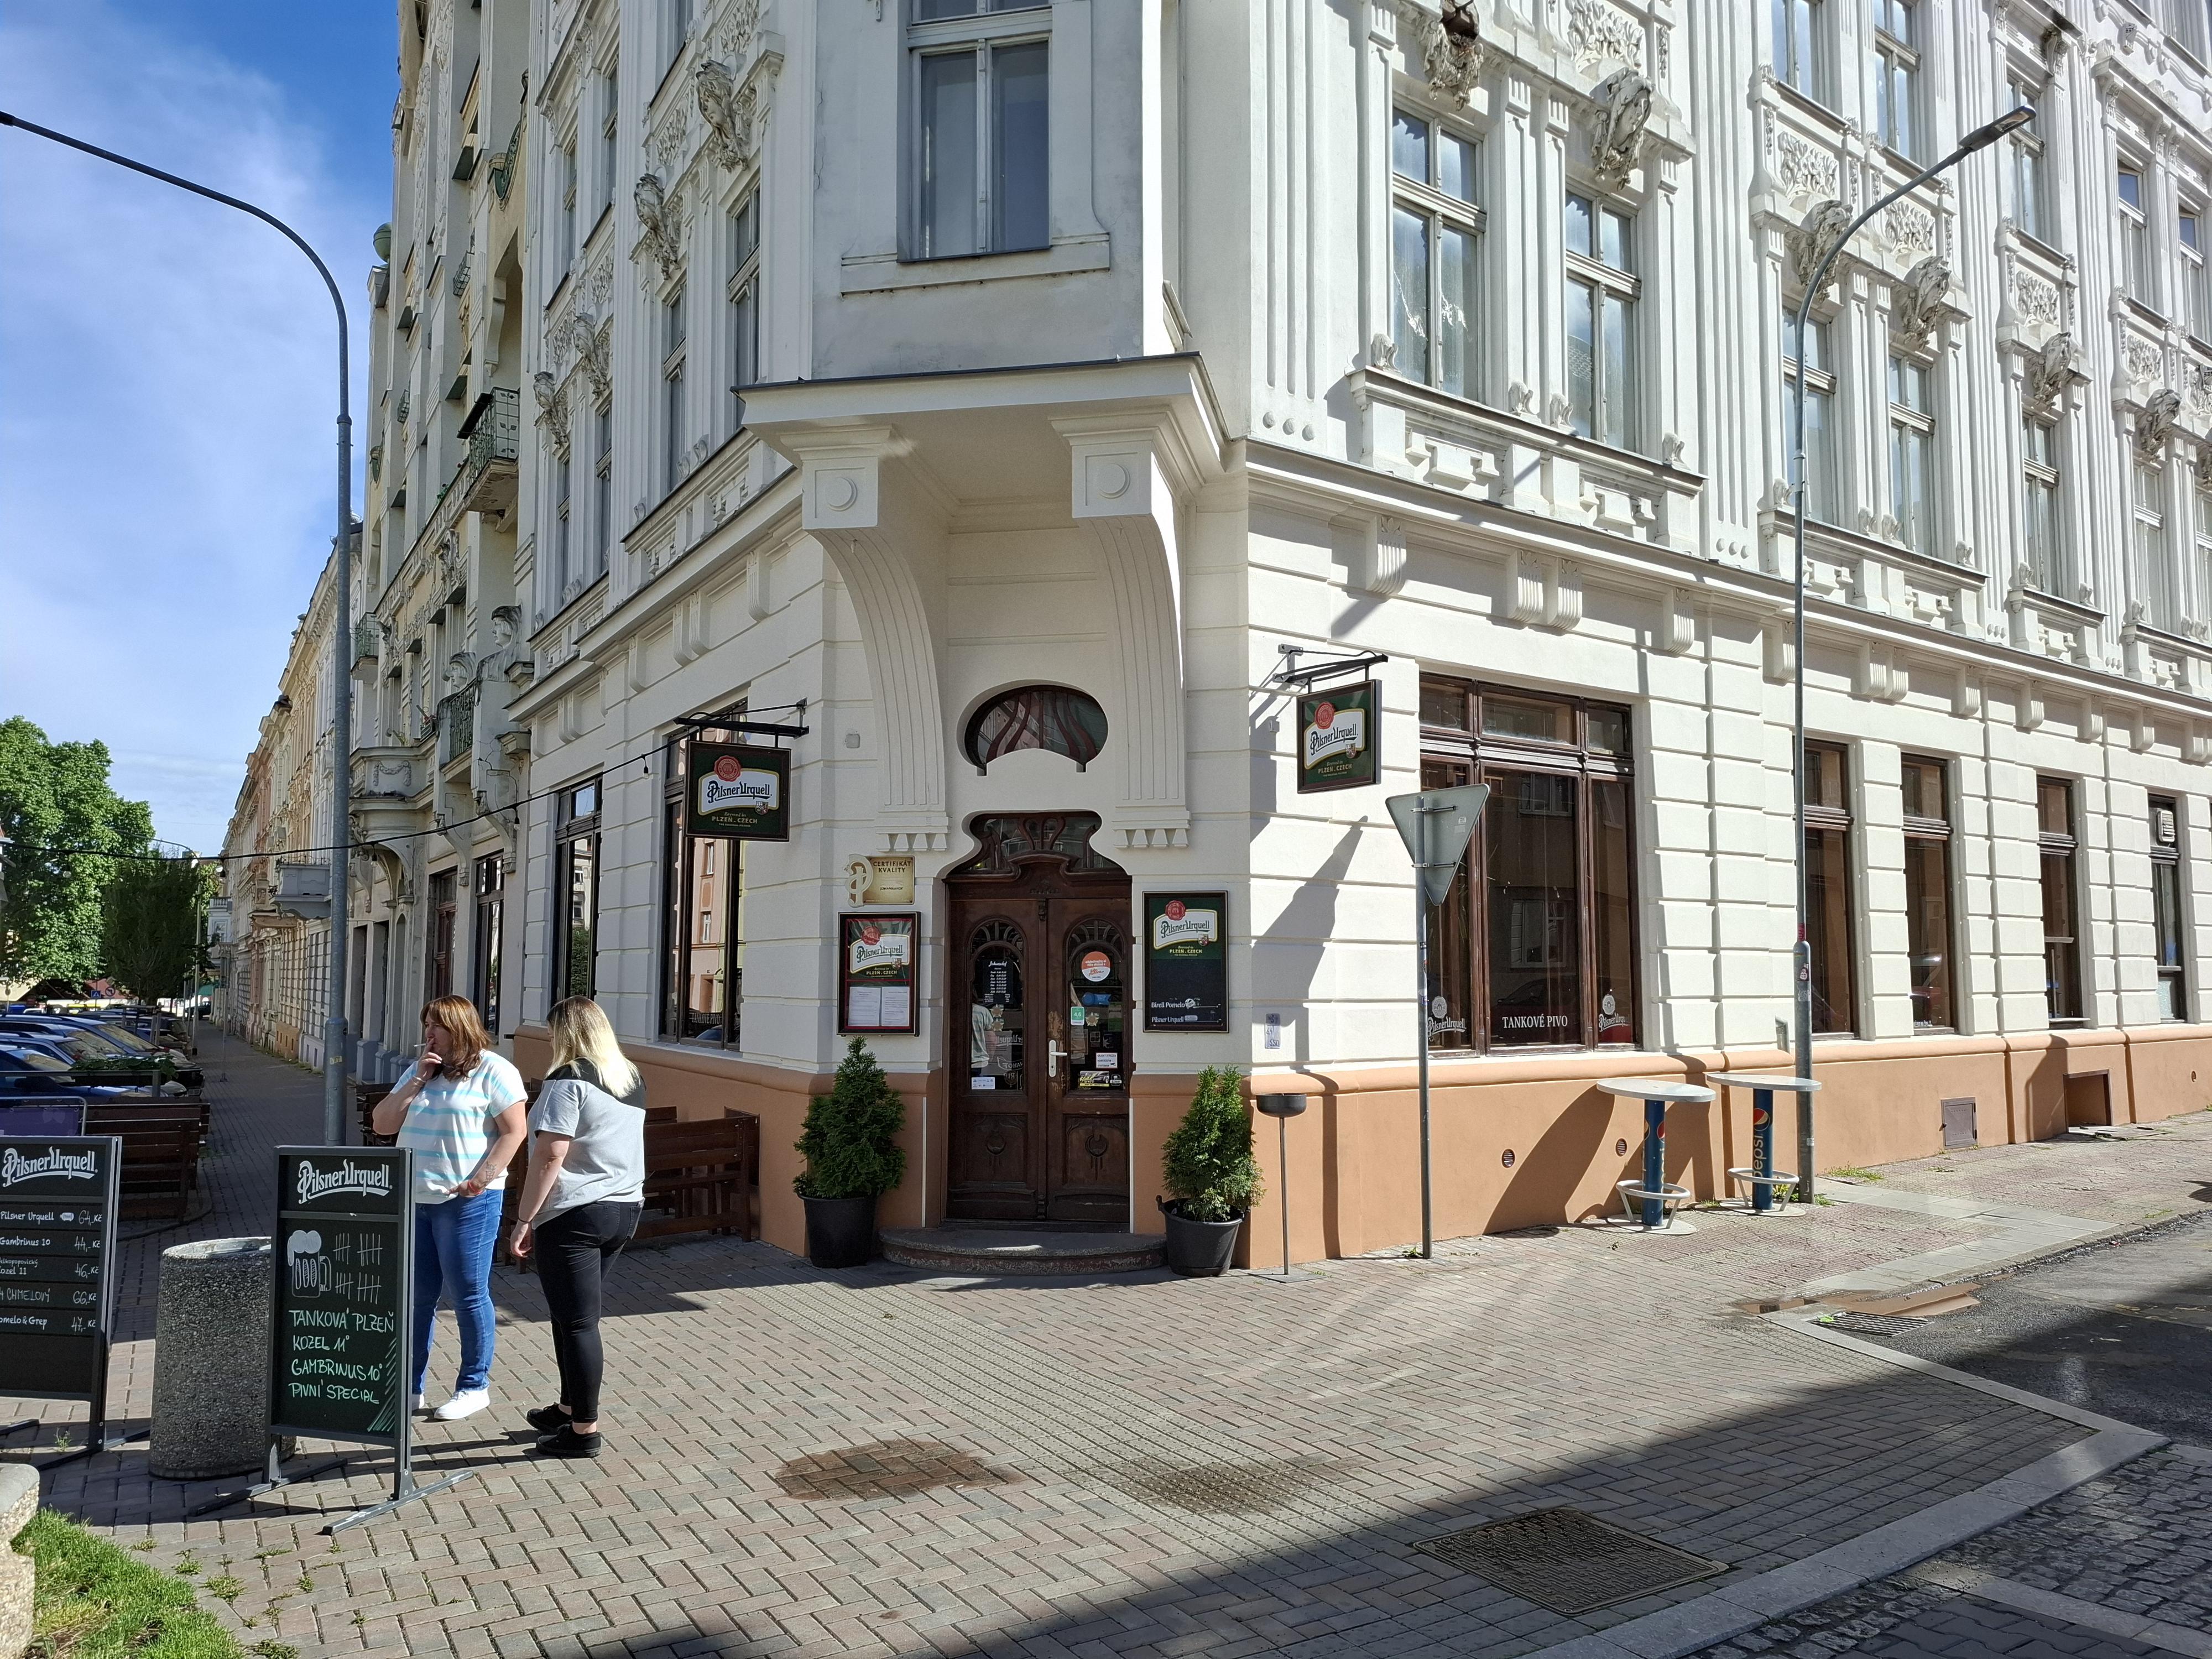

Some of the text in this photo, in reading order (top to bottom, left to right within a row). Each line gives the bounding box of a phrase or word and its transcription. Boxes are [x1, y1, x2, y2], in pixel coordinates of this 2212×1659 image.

[1310, 723, 1357, 756] Pilsner Urquell
[707, 780, 770, 804] Pilsner Urquell
[1160, 920, 1209, 938] Pilsner Urquell
[857, 945, 902, 963] Pilsner Urquell
[1427, 1016, 1465, 1037] Pilsner Urquell
[1502, 1013, 1568, 1029] TANKOVÉ PIVO
[1599, 1014, 1615, 1032] Pilsner
[2, 1146, 96, 1187] Pilsner Urquell
[298, 1159, 389, 1204] Pilsner Urquell
[1, 1211, 25, 1220] Pilsner
[28, 1212, 55, 1225] Urquell
[0, 1235, 39, 1246] Gambrinus
[0, 1257, 38, 1267] elkopopovický
[7, 1287, 50, 1302] CHMELOVÝ
[289, 1307, 394, 1333] TANKOVÁ PLZEŇ
[293, 1334, 330, 1351] KOZEL
[291, 1358, 367, 1381] GAMBRINUS
[288, 1379, 380, 1404] PIVNÍ SPECIAL
